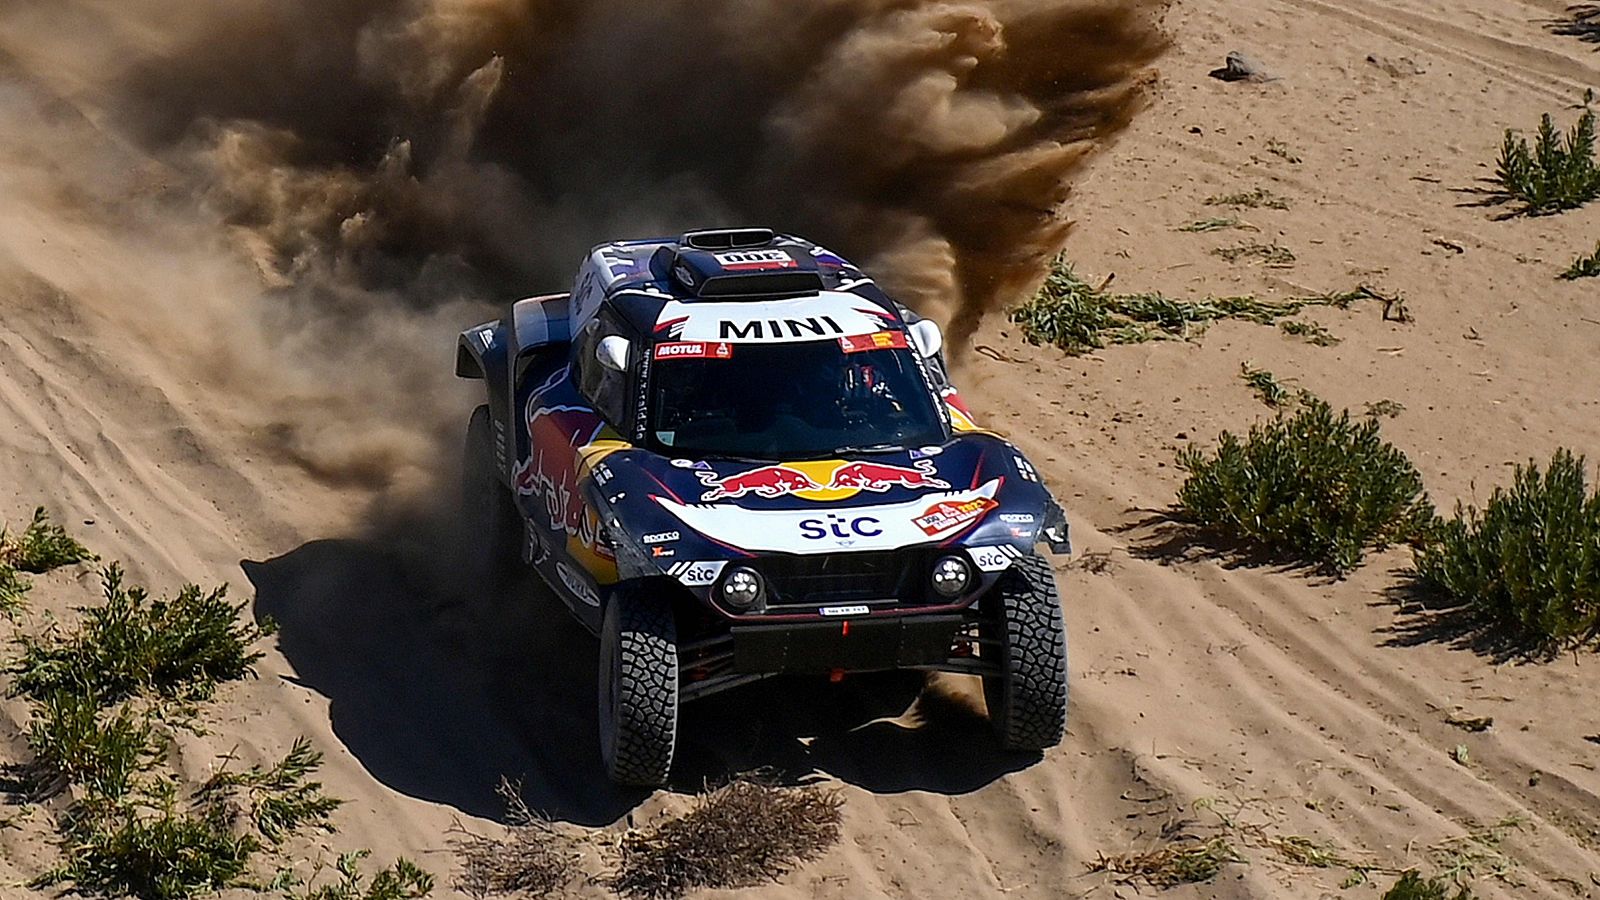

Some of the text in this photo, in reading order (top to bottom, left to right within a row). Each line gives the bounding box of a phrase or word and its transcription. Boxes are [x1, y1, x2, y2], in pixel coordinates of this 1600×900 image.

[719, 315, 844, 339] MINI
[657, 344, 703, 356] MOTUL
[643, 530, 680, 543] sparco
